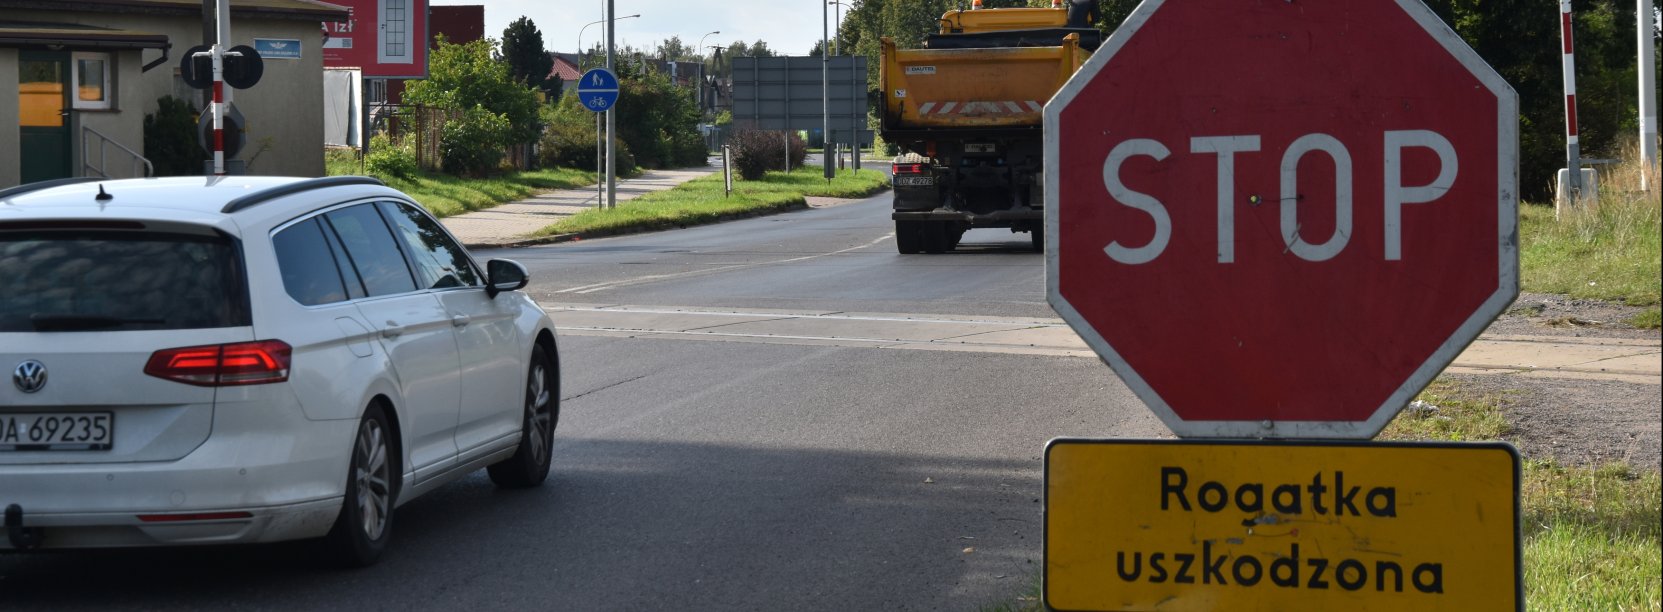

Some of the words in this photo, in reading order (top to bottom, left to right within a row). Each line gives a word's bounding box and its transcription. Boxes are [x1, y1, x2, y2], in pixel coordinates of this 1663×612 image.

[1103, 129, 1459, 265] STOP
[28, 416, 107, 442] 69235
[1160, 466, 1397, 527] Rogatka
[1116, 540, 1444, 594] uszkodzona
